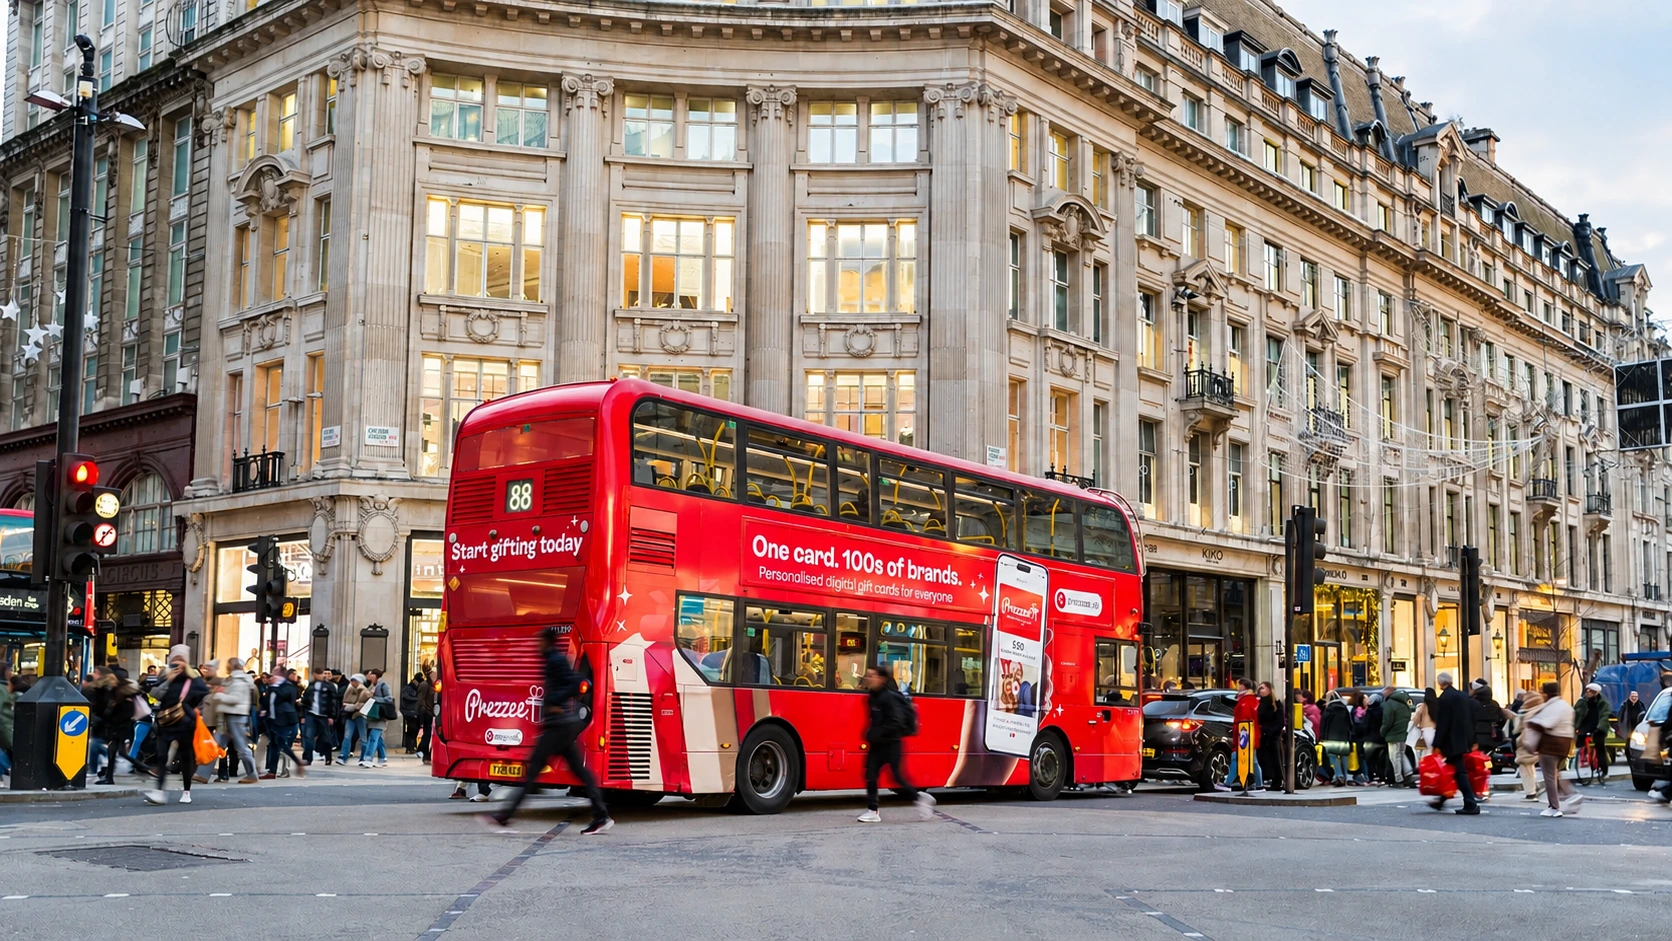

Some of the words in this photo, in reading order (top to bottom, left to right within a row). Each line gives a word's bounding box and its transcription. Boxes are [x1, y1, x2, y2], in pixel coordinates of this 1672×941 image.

[509, 483, 532, 511] 88
[451, 541, 488, 561] Start
[490, 536, 537, 562] gifting
[540, 533, 583, 557] today
[752, 534, 790, 561] One
[793, 546, 839, 568] card.
[842, 549, 884, 575] 100s
[886, 557, 905, 578] of
[907, 559, 962, 586] brands.
[1202, 548, 1224, 561] KIKO
[107, 564, 159, 583] CIRCUS
[759, 566, 824, 587] Personalised
[825, 575, 857, 592] digital
[857, 580, 873, 595] gift
[874, 583, 900, 597] cards
[901, 584, 913, 598] for
[914, 589, 953, 605] everyone
[465, 688, 529, 723] Prezzee
